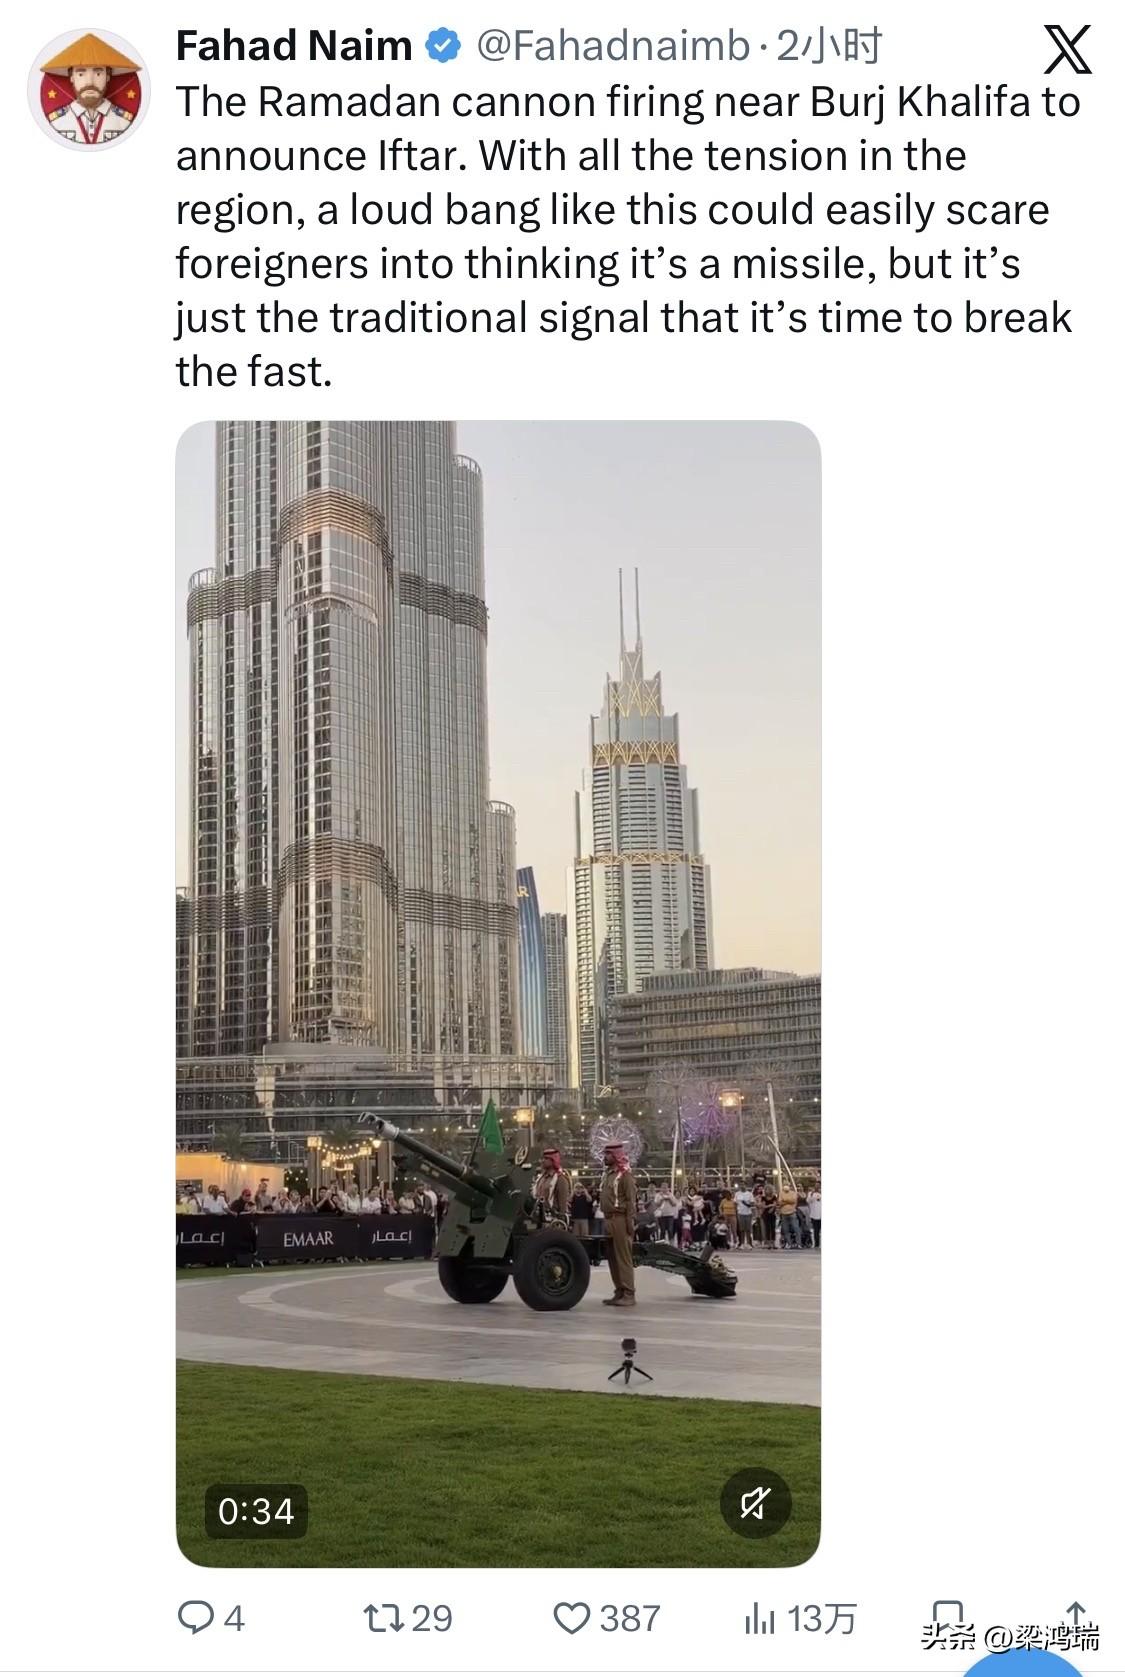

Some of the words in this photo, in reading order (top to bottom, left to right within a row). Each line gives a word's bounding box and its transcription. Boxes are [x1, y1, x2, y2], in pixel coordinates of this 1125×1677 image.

[178, 28, 296, 61] Fahad
[310, 28, 411, 61] Naim
[478, 28, 749, 61] @Fahadnaimb
[778, 26, 882, 64] 2小时
[176, 84, 246, 117] The
[260, 84, 439, 117] Ramadan
[453, 93, 594, 117] cannon
[606, 84, 704, 125] firing
[716, 93, 800, 117] near
[812, 85, 884, 125] Burj
[899, 84, 1029, 117] Khalifa
[1041, 87, 1080, 117] to
[177, 138, 366, 171] announce
[380, 138, 466, 171] Iftar.
[479, 138, 565, 171] With
[579, 138, 618, 171] all
[631, 138, 693, 171] the
[705, 139, 846, 171] tension
[861, 139, 891, 171] in
[903, 138, 966, 171] the
[178, 193, 304, 233] region,
[318, 201, 337, 225] a
[352, 192, 431, 225] loud
[447, 192, 540, 233] bang
[552, 192, 615, 225] like
[626, 192, 696, 225] this
[709, 192, 812, 225] could
[827, 192, 935, 233] easily
[947, 201, 1049, 225] scare
[176, 246, 367, 287] foreigners
[382, 247, 453, 279] into
[464, 246, 619, 287] thinking
[632, 246, 686, 279] it’s
[700, 255, 719, 279] a
[734, 246, 875, 284] missile,
[890, 246, 951, 279] but
[964, 246, 1019, 279] it’s
[173, 301, 245, 341] just
[256, 300, 318, 333] the
[329, 300, 525, 333] traditional
[540, 300, 647, 341] signal
[660, 300, 738, 333] that
[752, 300, 806, 333] it’s
[818, 300, 902, 333] time
[913, 303, 952, 333] to
[966, 300, 1072, 333] break
[175, 354, 237, 387] the
[248, 354, 331, 387] fast.
[284, 1231, 334, 1247] EMAAR
[218, 1497, 295, 1525] 0:34
[224, 1605, 245, 1632] 4
[413, 1605, 452, 1632] 29
[601, 1605, 660, 1632] 387
[788, 1603, 857, 1635] 13万
